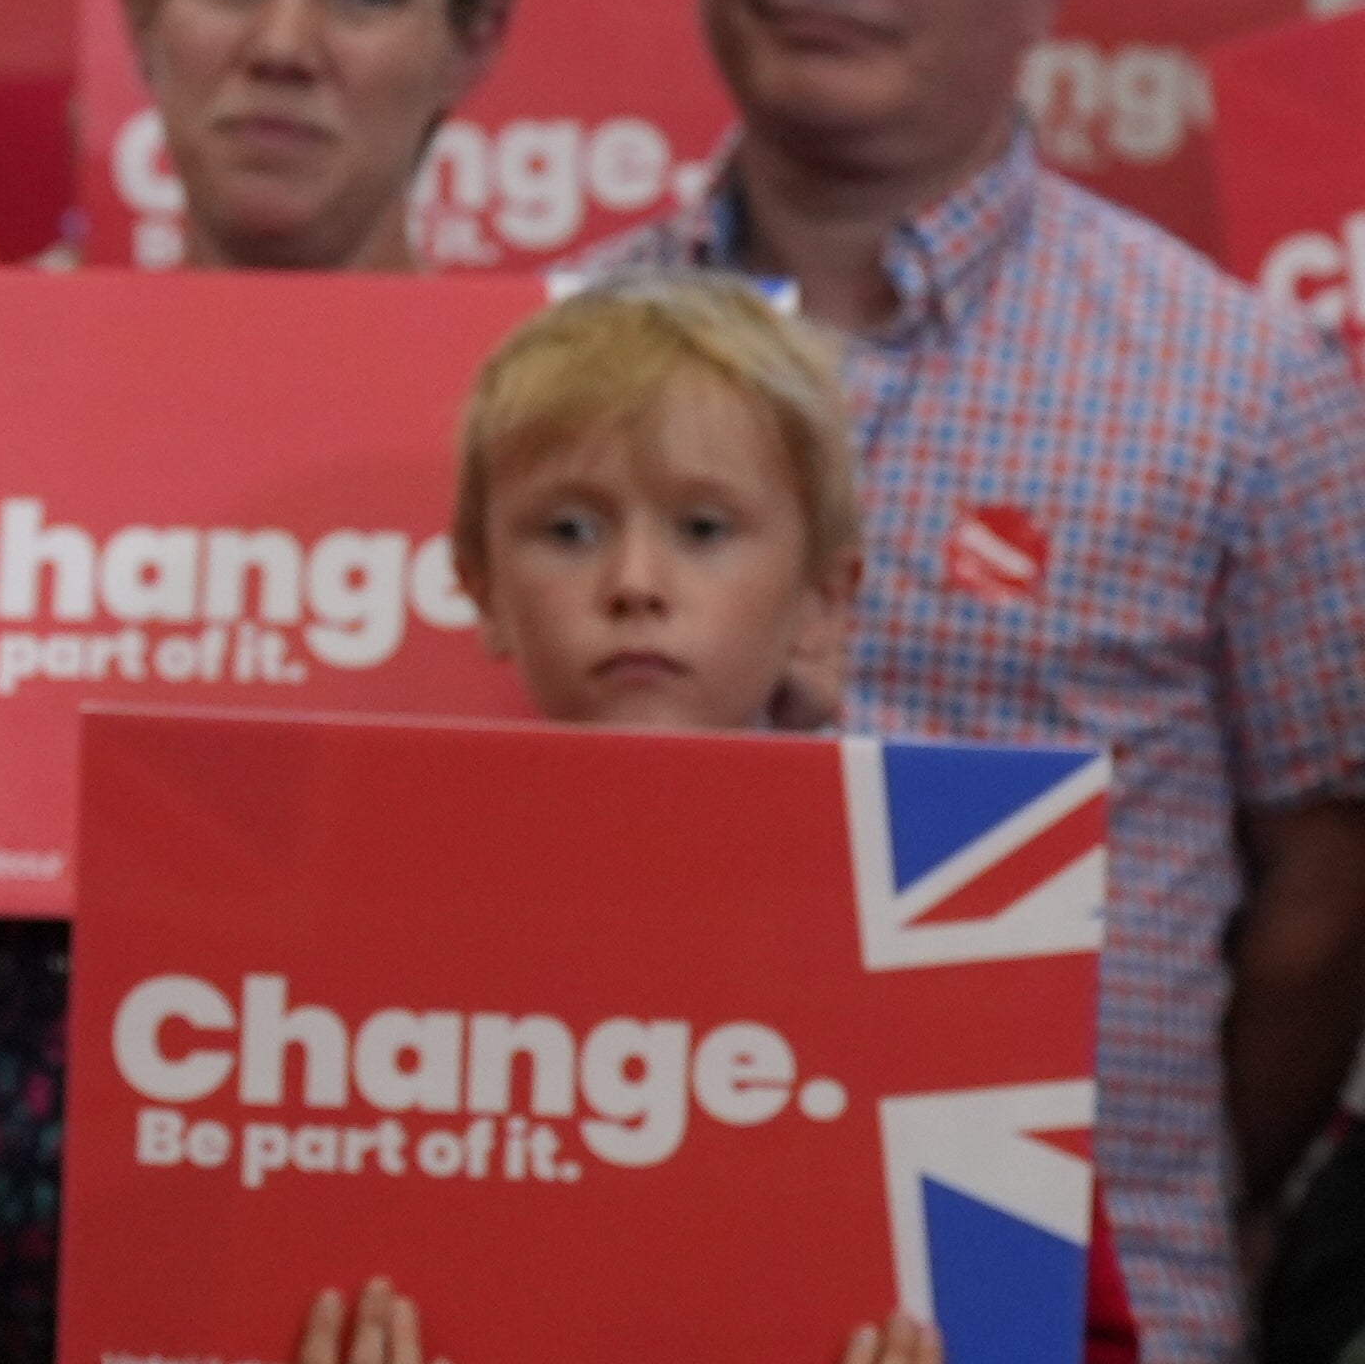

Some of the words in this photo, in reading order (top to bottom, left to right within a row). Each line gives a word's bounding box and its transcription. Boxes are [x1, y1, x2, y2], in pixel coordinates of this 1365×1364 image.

[153, 626, 226, 682] of
[231, 619, 307, 684] it.
[111, 974, 849, 1166] Change.
[136, 1108, 231, 1170] Be
[241, 1118, 407, 1190] part
[416, 1117, 497, 1180] of
[503, 1114, 583, 1183] it.
